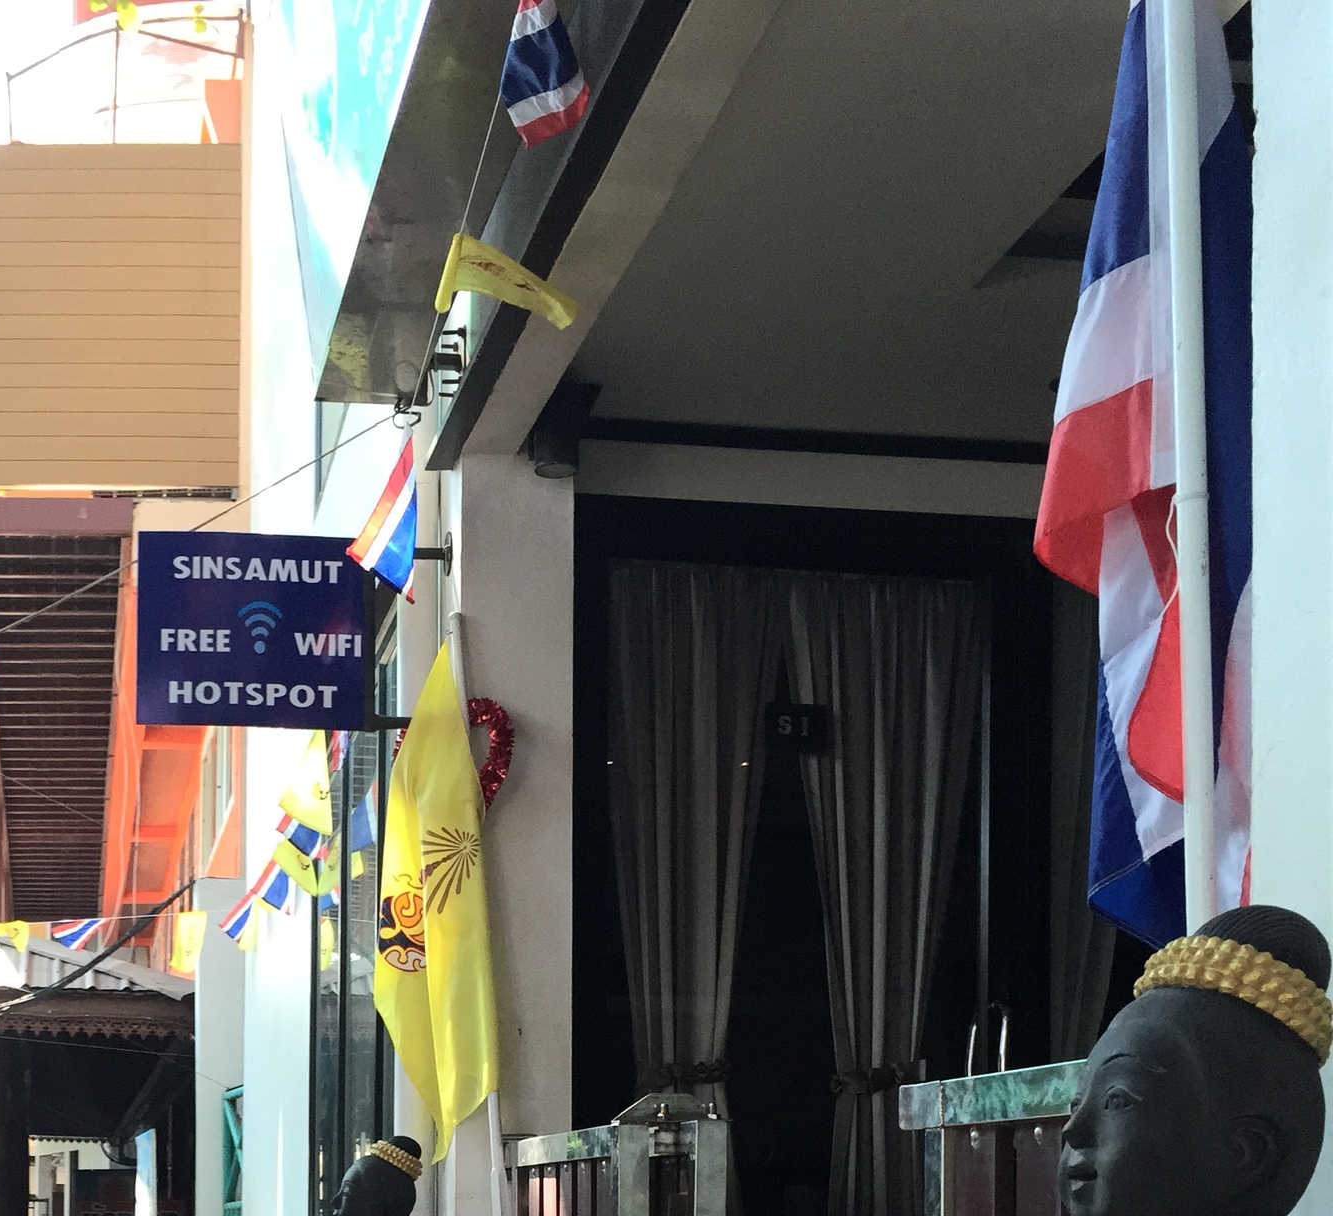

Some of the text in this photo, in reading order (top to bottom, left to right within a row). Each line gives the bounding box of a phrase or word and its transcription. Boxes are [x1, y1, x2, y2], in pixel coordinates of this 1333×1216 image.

[173, 555, 343, 584] SINSAMUT
[160, 628, 362, 658] FREE WIFI
[168, 681, 338, 709] HOTSPOT
